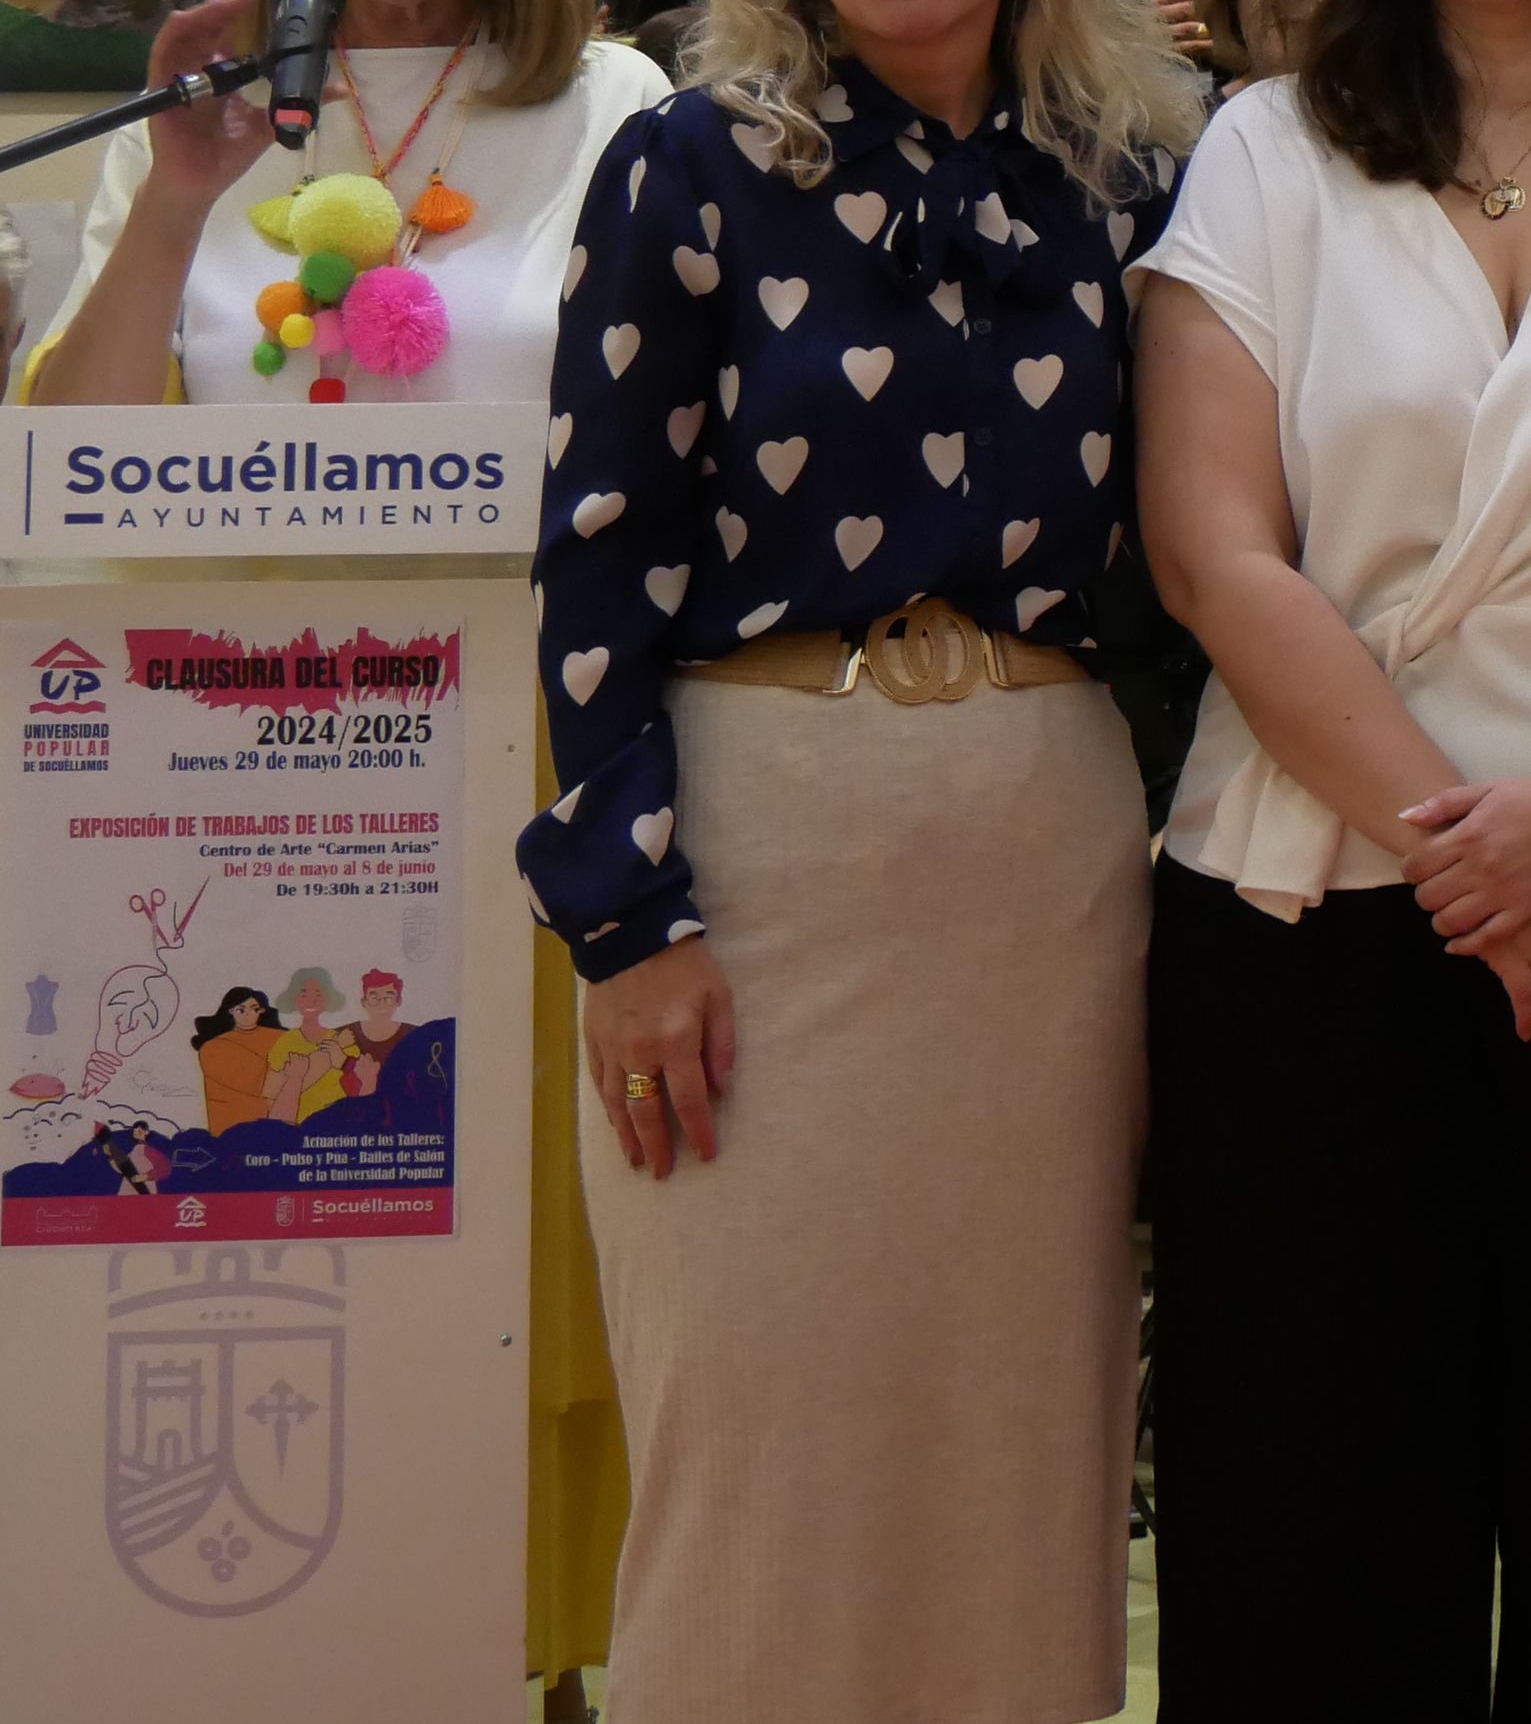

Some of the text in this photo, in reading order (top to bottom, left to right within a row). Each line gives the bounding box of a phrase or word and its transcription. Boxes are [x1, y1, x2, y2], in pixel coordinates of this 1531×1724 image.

[66, 440, 505, 494] Socuéllamos
[117, 503, 500, 529] AYUNTAMIENTO
[146, 654, 440, 690] CLAUSURA DEL CURSO
[40, 669, 102, 701] UP
[24, 723, 109, 739] UNIVERSIDAD
[257, 713, 433, 752] 2024/2025
[24, 740, 110, 757] POPULAR
[23, 757, 109, 772] DE SOCUÉLLAMOS
[167, 748, 426, 774] Jueves 29 de mayo 20:00 h.
[69, 812, 440, 838] EXPOSICIÓN DE TRABAJOS DE LOS TALLERES
[200, 843, 252, 858] Centro
[257, 843, 275, 856] de
[280, 843, 312, 856] Arte
[223, 859, 436, 879] Del 29 de mayo al 8 de junio
[276, 880, 439, 897] De 19:30h a 21:30H
[302, 1133, 445, 1149] Actuación de los Talleres:
[245, 1153, 271, 1167] Coro
[282, 1152, 313, 1166] Pulso
[316, 1154, 322, 1167] y
[359, 1150, 394, 1164] Bailes
[396, 1150, 411, 1163] de
[414, 1149, 445, 1163] Salón
[298, 1166, 445, 1183] de la Universidad Popular
[312, 1198, 434, 1215] Socuéllamos
